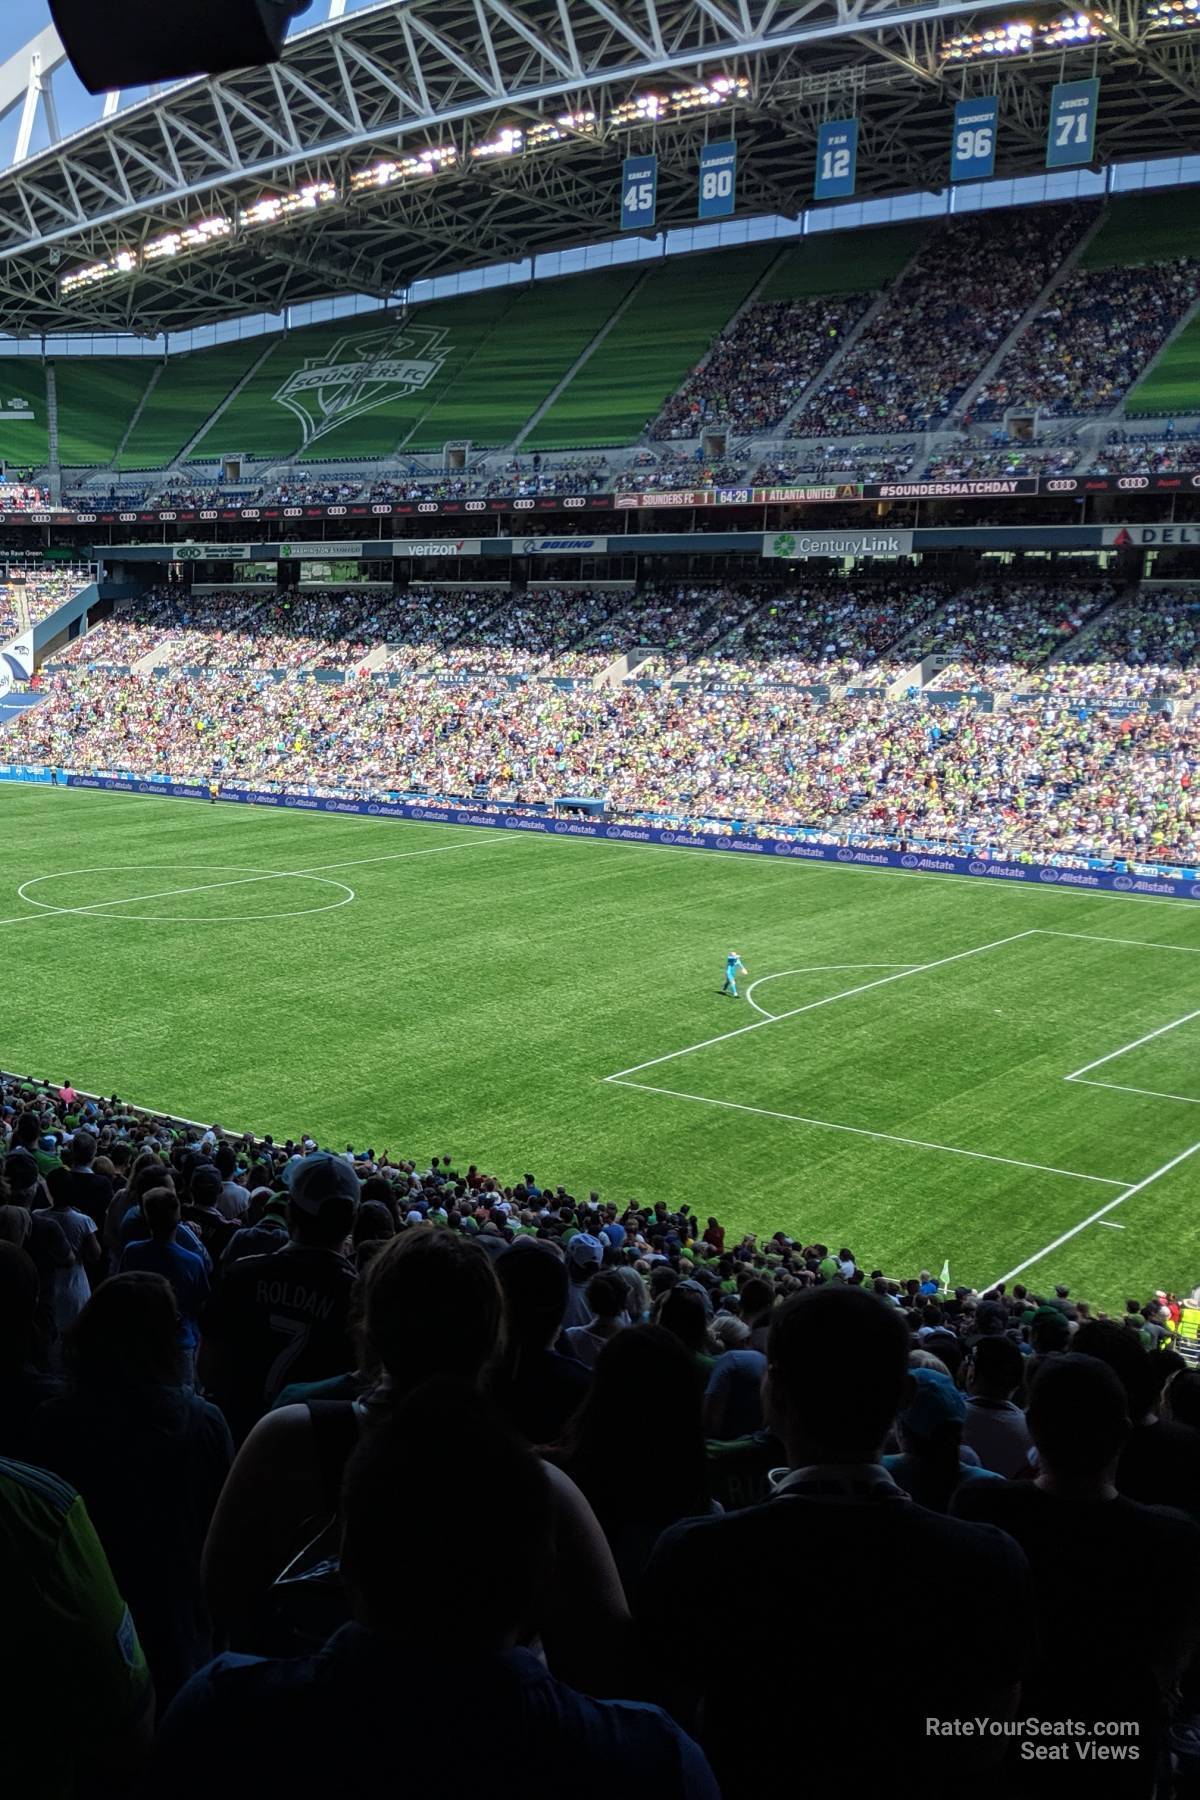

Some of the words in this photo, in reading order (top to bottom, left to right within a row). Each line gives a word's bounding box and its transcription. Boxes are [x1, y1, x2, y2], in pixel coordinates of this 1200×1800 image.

[1056, 113, 1088, 147] 71
[956, 128, 993, 160] 96
[822, 149, 850, 180] 12
[703, 170, 733, 199] 80
[624, 184, 653, 212] 45
[403, 368, 426, 381] FC
[769, 489, 804, 501] ATLANTA
[806, 487, 836, 500] UNITED
[880, 481, 1018, 497] #SOUNDERSMATCHDAY
[642, 493, 683, 506] SOUNDERS
[683, 493, 694, 504] FC
[720, 490, 748, 503] 64:29
[1142, 528, 1200, 543] DEL
[408, 542, 457, 556] verizon
[540, 540, 595, 550] BOEING
[800, 537, 899, 555] CenturyLink
[337, 802, 360, 811] Allstate
[379, 805, 404, 815] Allstate
[423, 811, 448, 821] Allstate
[469, 815, 496, 825] Allstate
[518, 820, 545, 830] Allstate
[568, 825, 596, 835] Allstate
[621, 830, 650, 840] Allstate
[674, 835, 705, 846] Allstate
[731, 840, 764, 851] Allstate
[791, 847, 825, 858] Allstate
[853, 852, 889, 864] Allstate
[918, 858, 956, 870] Allstate
[986, 865, 1026, 878] Allstate
[1059, 872, 1099, 885] Allstate
[1134, 880, 1175, 894] Allstate
[256, 1280, 336, 1320] ROLDAN
[264, 1312, 312, 1404] 7
